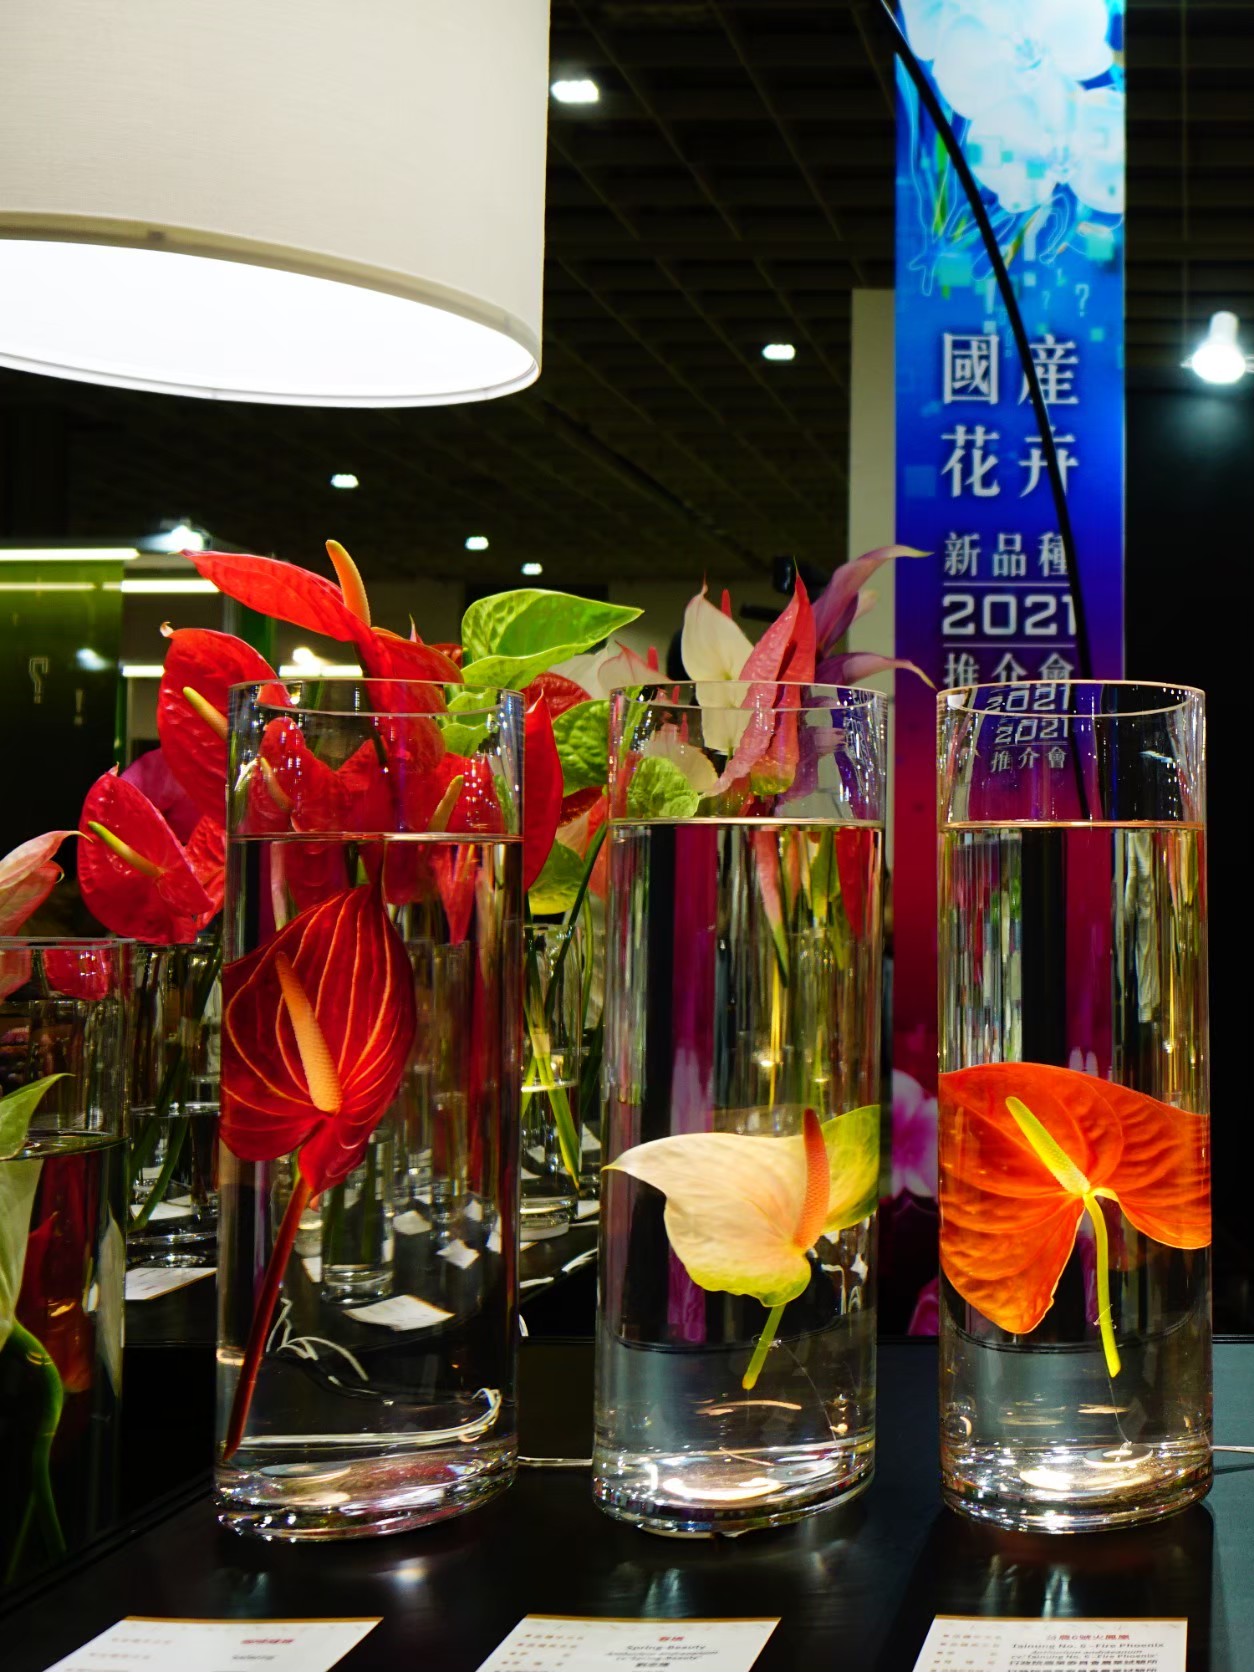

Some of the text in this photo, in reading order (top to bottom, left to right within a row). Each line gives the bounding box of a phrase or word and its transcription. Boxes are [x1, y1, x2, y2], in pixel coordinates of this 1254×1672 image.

[940, 424, 1080, 498] 花卉
[944, 531, 1069, 578] 新品種
[942, 594, 1077, 636] 2021
[991, 746, 1067, 773] 推介會
